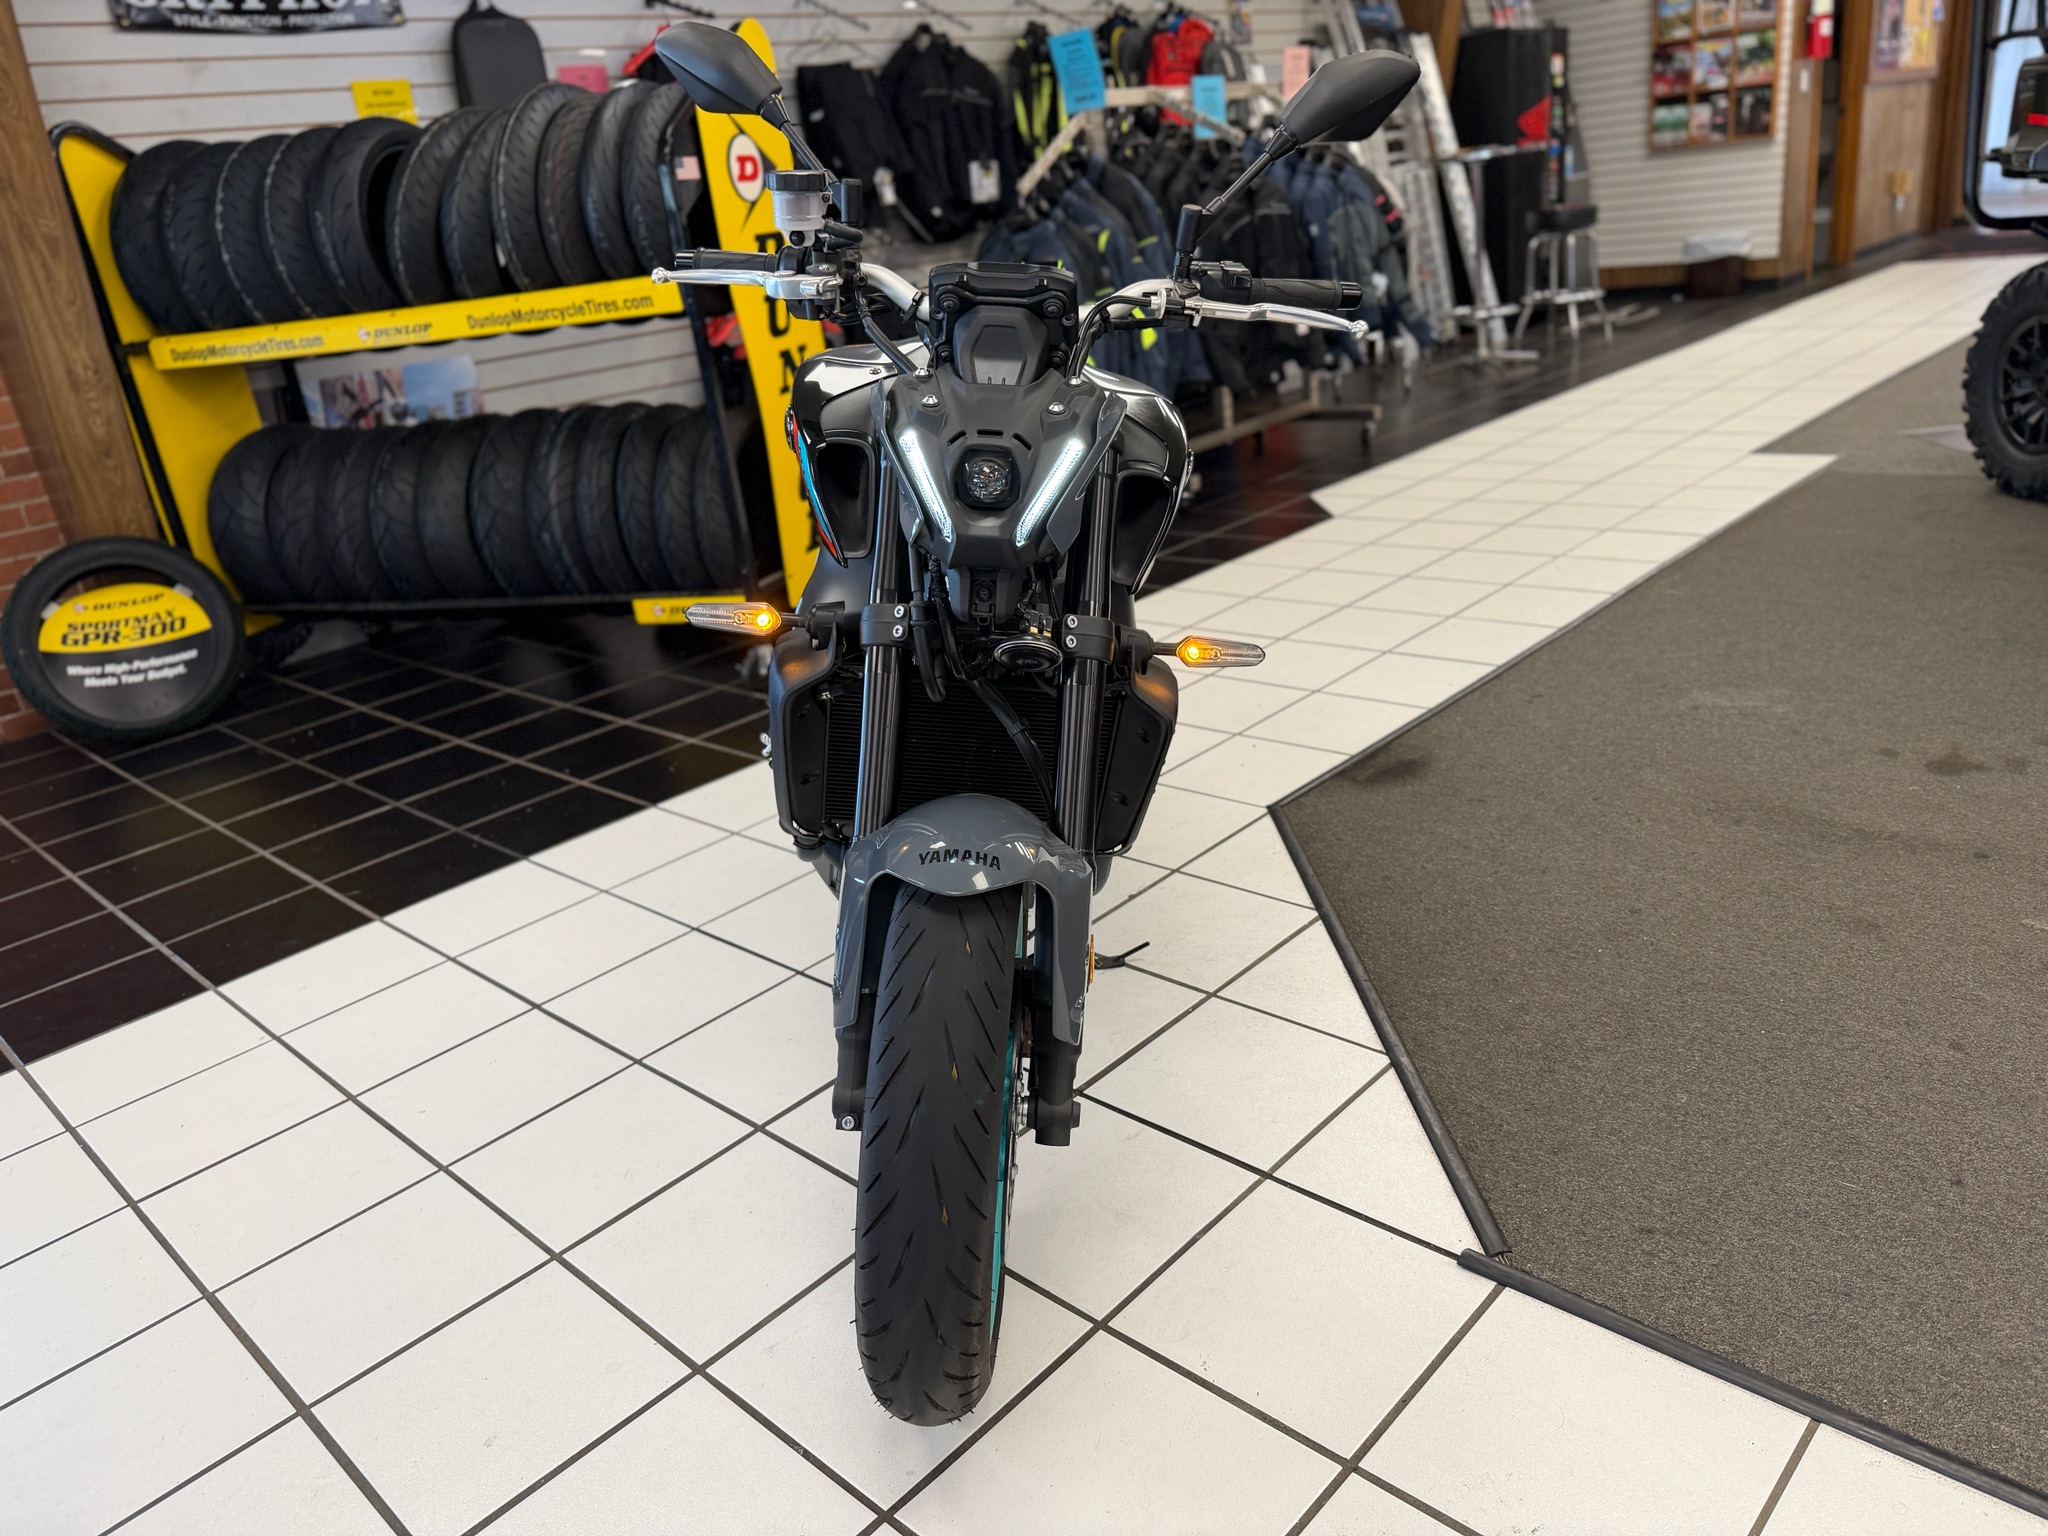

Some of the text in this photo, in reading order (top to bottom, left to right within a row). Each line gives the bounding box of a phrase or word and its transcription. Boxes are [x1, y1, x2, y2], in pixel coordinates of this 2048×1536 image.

[218, 14, 282, 28] FUNCTION
[736, 155, 759, 182] D
[467, 294, 654, 330] DunlopMotorcycleTires.com
[374, 322, 432, 339] DUNLOP
[93, 592, 165, 612] DUNLOP
[61, 616, 187, 647] GPR-300
[67, 606, 176, 632] SPORTMAX
[918, 848, 1001, 872] YAMAHA
